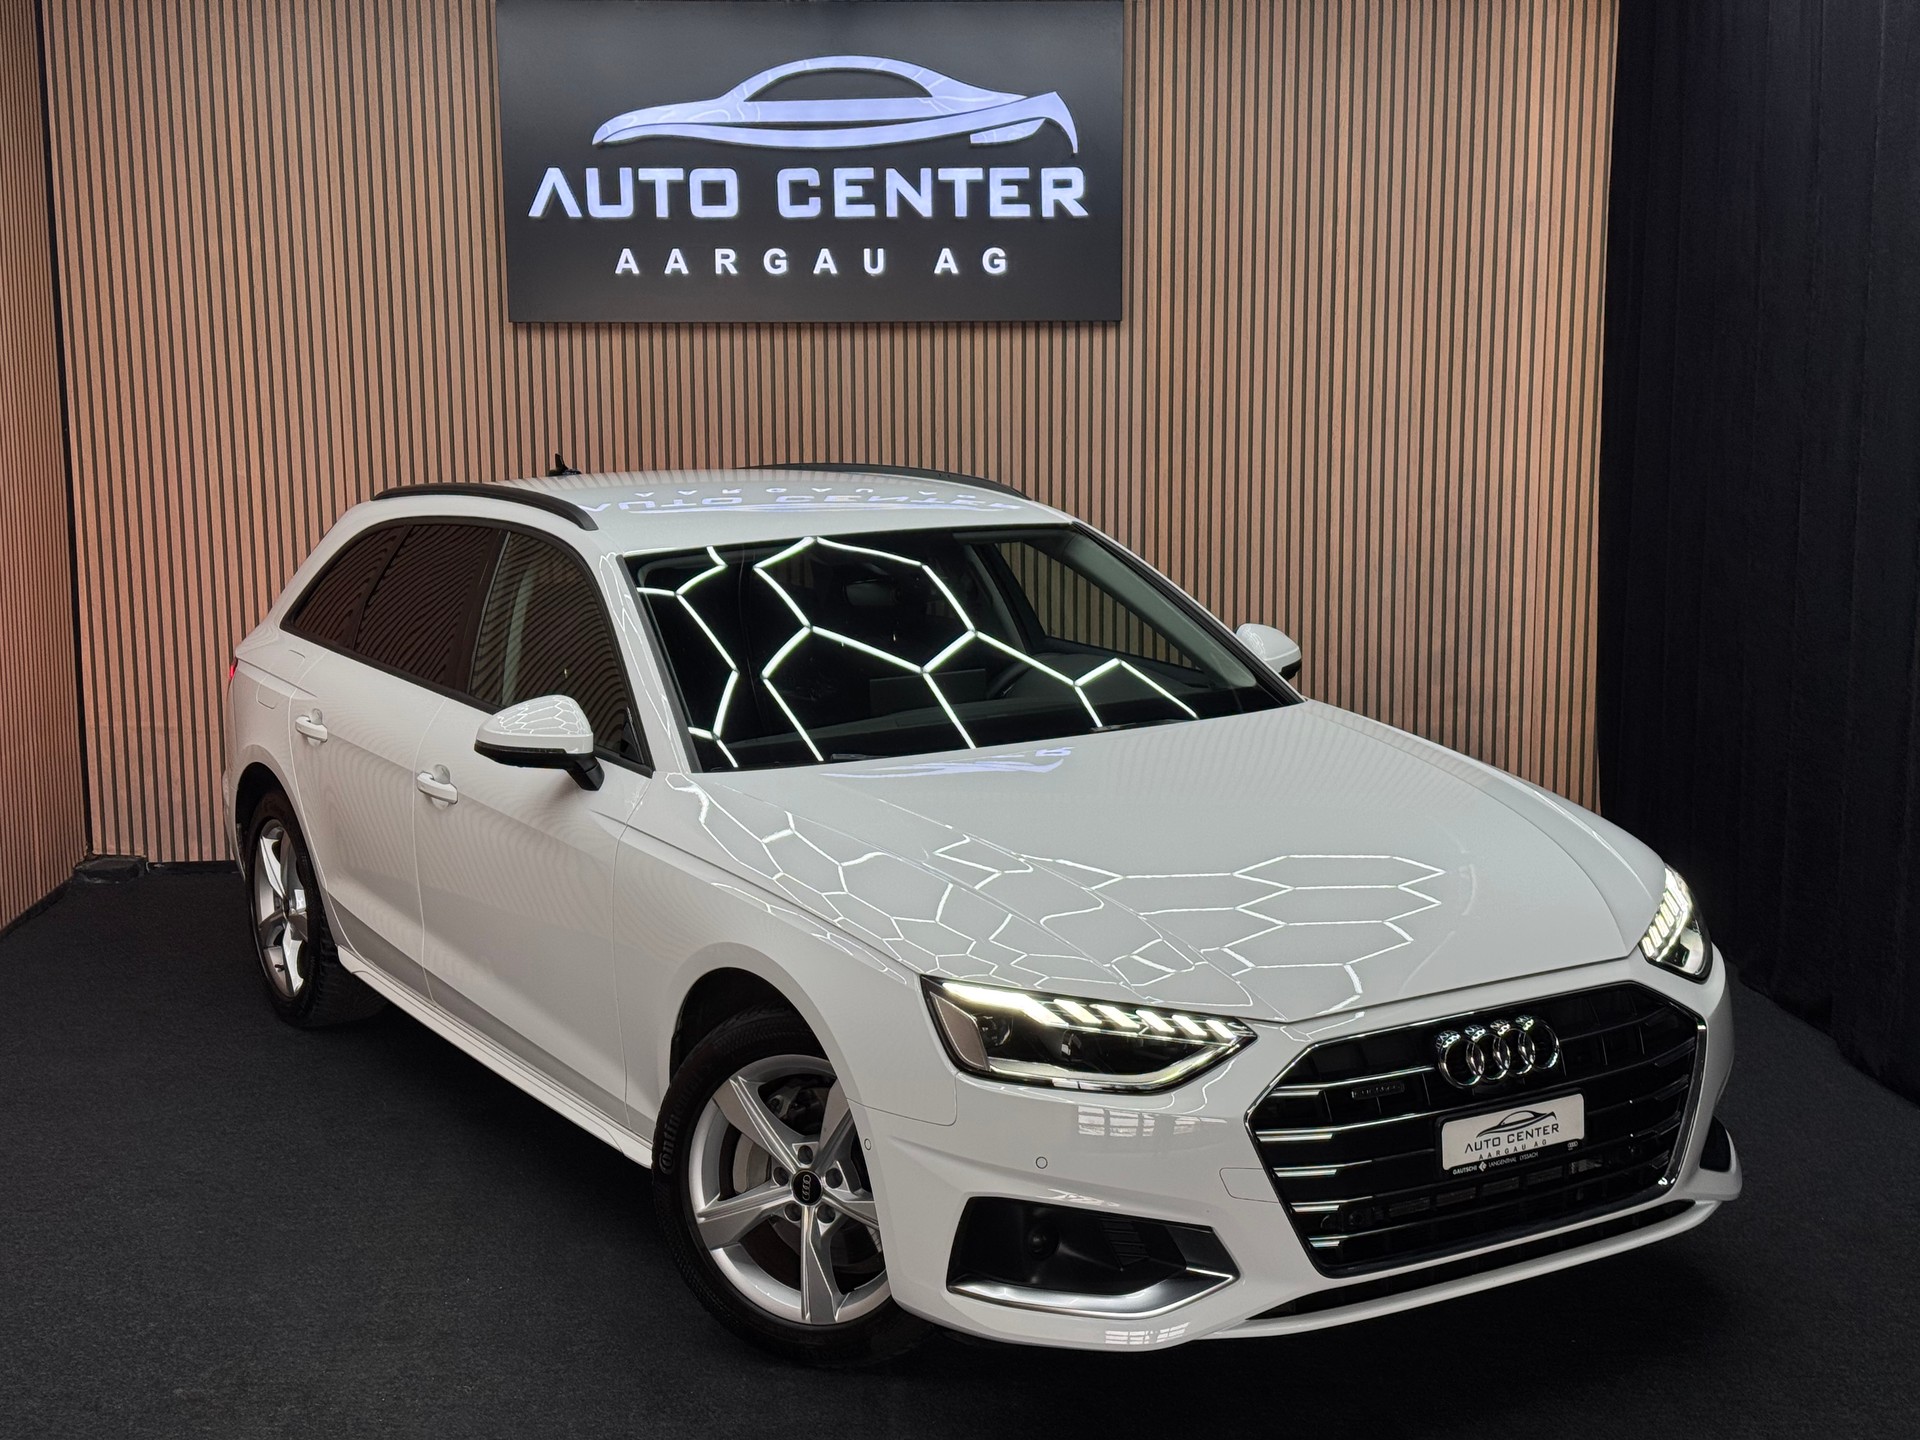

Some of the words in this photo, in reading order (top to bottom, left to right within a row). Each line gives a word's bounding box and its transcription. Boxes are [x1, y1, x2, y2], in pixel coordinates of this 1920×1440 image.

[528, 166, 739, 218] AUTO
[777, 166, 1089, 218] CENTER
[614, 247, 887, 275] AARGAU
[933, 247, 1008, 275] AG
[1464, 1137, 1501, 1154] AUTO
[1507, 1123, 1560, 1144] CENTER
[1478, 1144, 1527, 1160] AARGAU
[1452, 1165, 1478, 1175] GAUTSCHI
